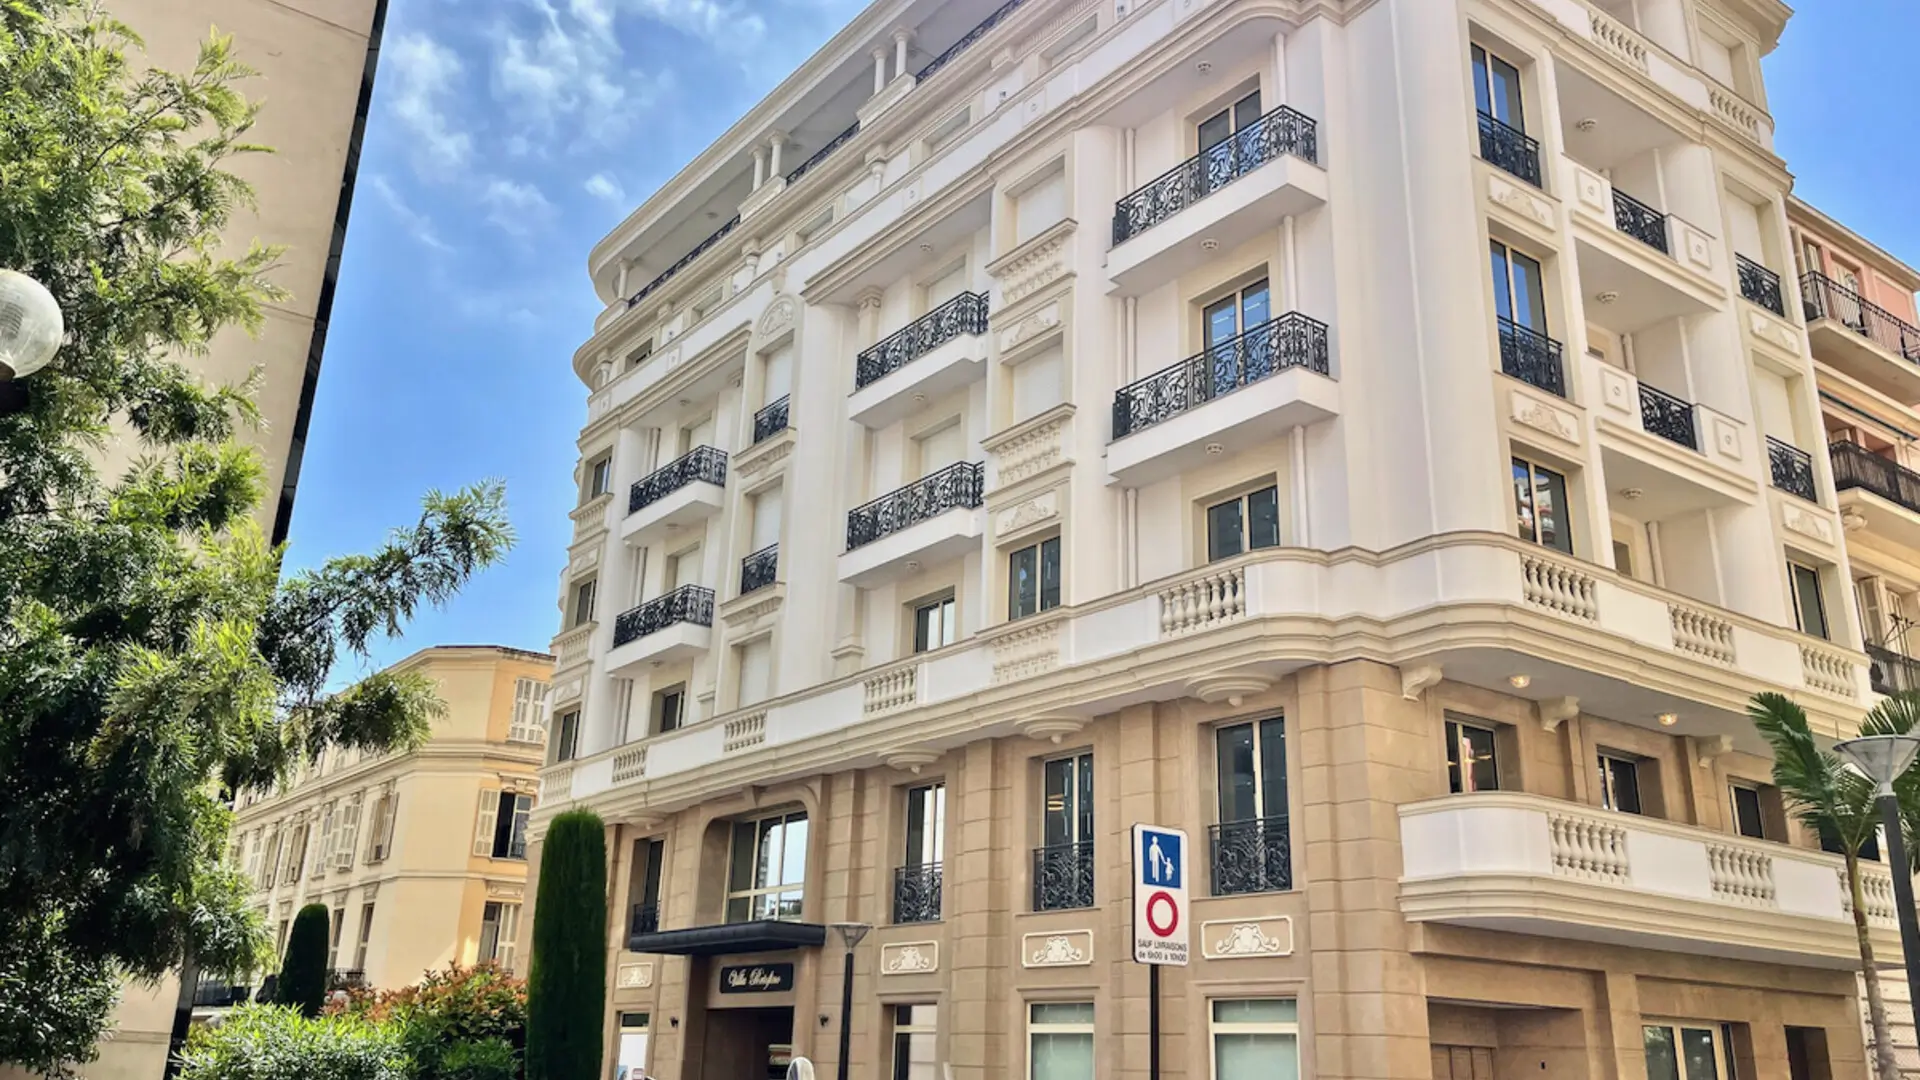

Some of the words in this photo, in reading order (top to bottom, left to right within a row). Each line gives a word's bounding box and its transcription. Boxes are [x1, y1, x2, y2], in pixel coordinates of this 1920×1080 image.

[1138, 939, 1152, 948] SAUF
[1154, 941, 1187, 952] LIVRAISONS
[1138, 951, 1146, 959] de
[728, 969, 747, 987] Villa
